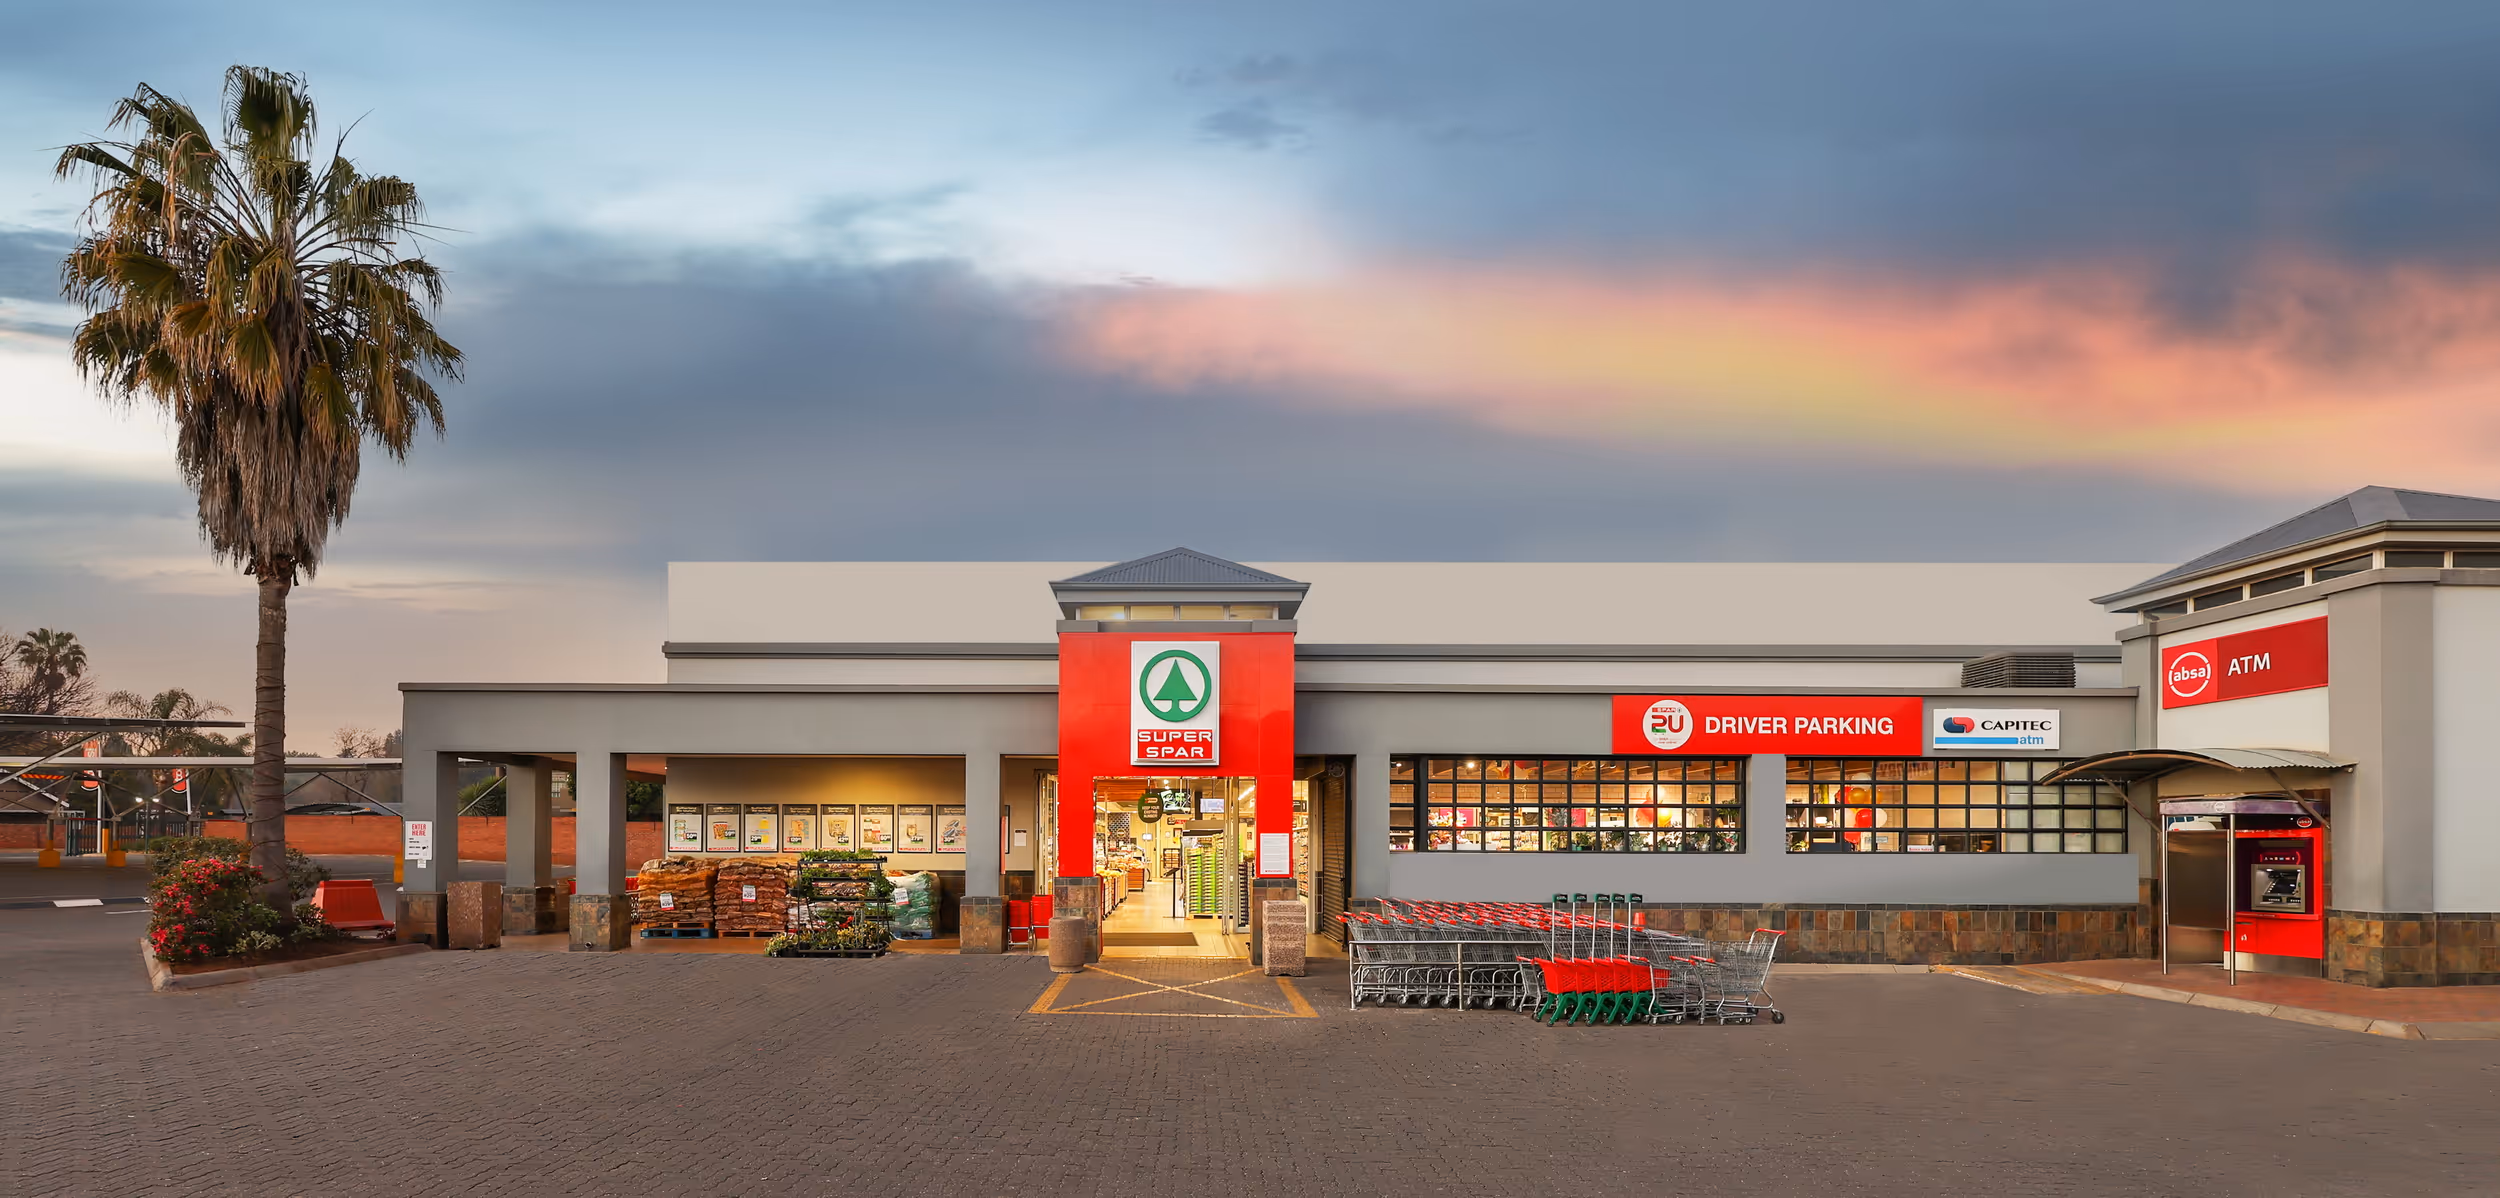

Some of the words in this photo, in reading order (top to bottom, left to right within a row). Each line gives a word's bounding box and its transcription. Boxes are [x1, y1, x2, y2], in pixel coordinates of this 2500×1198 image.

[2227, 652, 2271, 676] ATM
[2173, 665, 2208, 681] absa
[1651, 714, 1685, 734] 2U
[1704, 716, 1787, 735] DRIVER
[1793, 717, 1894, 735] PARKING
[1980, 719, 2053, 732] CAPITEC
[1137, 730, 1213, 743] SUPER
[2018, 734, 2044, 746] atm
[1145, 746, 1205, 758] SPAR
